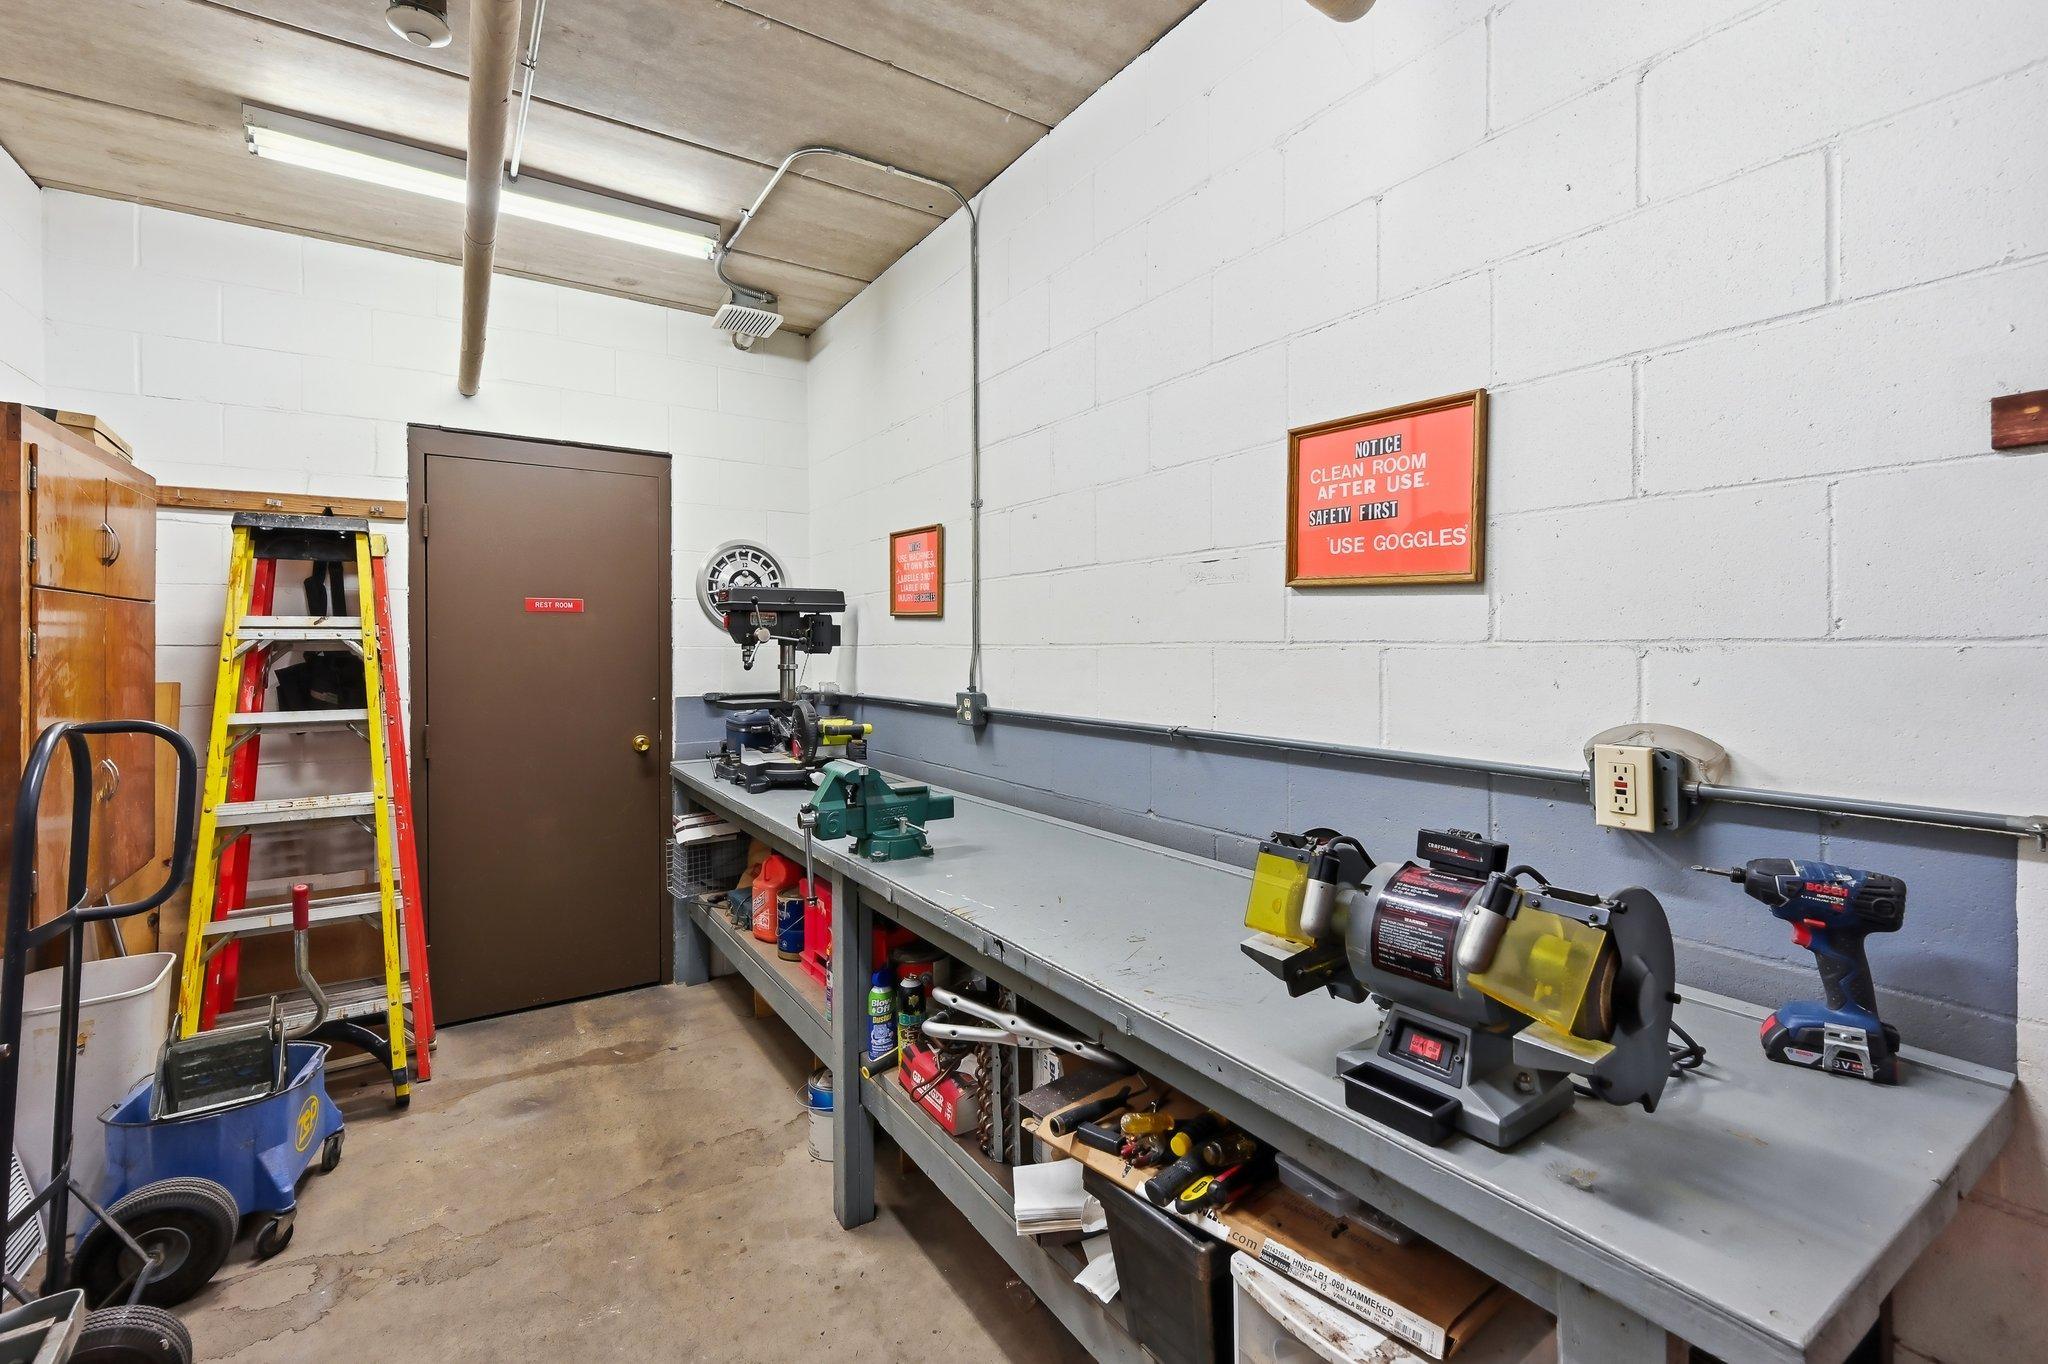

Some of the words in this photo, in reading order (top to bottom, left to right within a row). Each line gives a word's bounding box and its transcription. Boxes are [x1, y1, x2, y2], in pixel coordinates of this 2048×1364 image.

[1355, 435, 1401, 459] NOTICE
[1310, 462, 1364, 484] CLEAN
[1372, 452, 1427, 475] ROOM
[1318, 479, 1376, 501] AFTER
[1309, 506, 1351, 526] SAFETY
[1359, 501, 1398, 520] FIRST
[555, 601, 573, 609] ROOM
[826, 810, 839, 833] 6
[1427, 842, 1459, 854] CRAFTSMAN
[1806, 882, 1849, 897] BOSCH
[1228, 1232, 1258, 1251] .com
[1292, 1258, 1313, 1273] HNSP
[1346, 1286, 1394, 1318] HAMMERED
[1320, 1282, 1327, 1292] 12
[1333, 1291, 1355, 1308] VANILLA
[1355, 1303, 1372, 1316] BEAN
